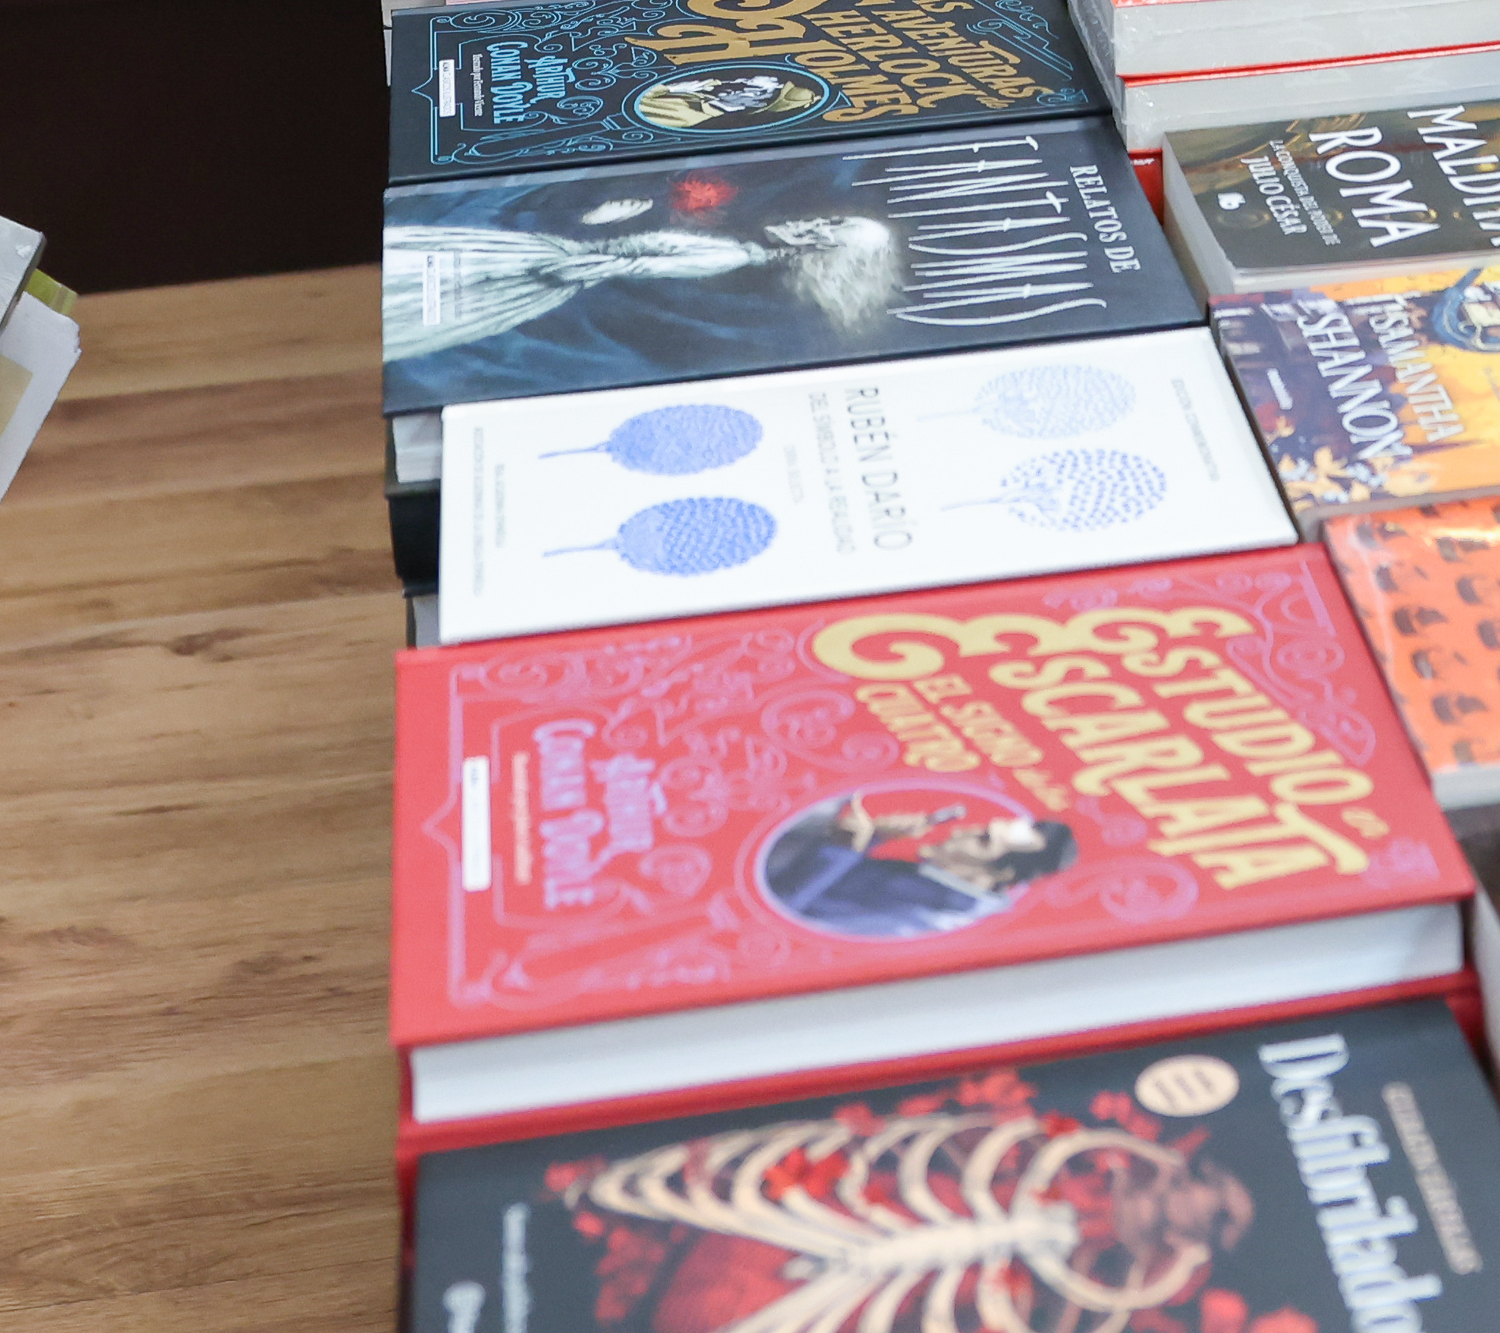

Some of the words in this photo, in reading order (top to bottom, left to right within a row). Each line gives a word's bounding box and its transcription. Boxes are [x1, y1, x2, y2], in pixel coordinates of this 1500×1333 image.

[488, 42, 526, 80] CONAN
[489, 78, 530, 124] DOYLE
[524, 56, 562, 104] ARTHUR
[625, 21, 896, 124] HOLMES
[872, 10, 1052, 101] AVENTURAS
[842, 135, 1107, 326] FANTASMAS
[1070, 164, 1127, 245] RELATOS
[1104, 246, 1141, 274] DE
[1241, 156, 1283, 195] JULIO
[1264, 193, 1307, 235] CÉSAR
[1310, 127, 1440, 247] ROMA
[845, 386, 893, 464] RUBÉN
[1299, 313, 1411, 460] SHANNON
[861, 470, 913, 552] DARÍO
[813, 611, 1368, 889] ESCARLATA
[1072, 605, 1374, 807] ESTUDIO
